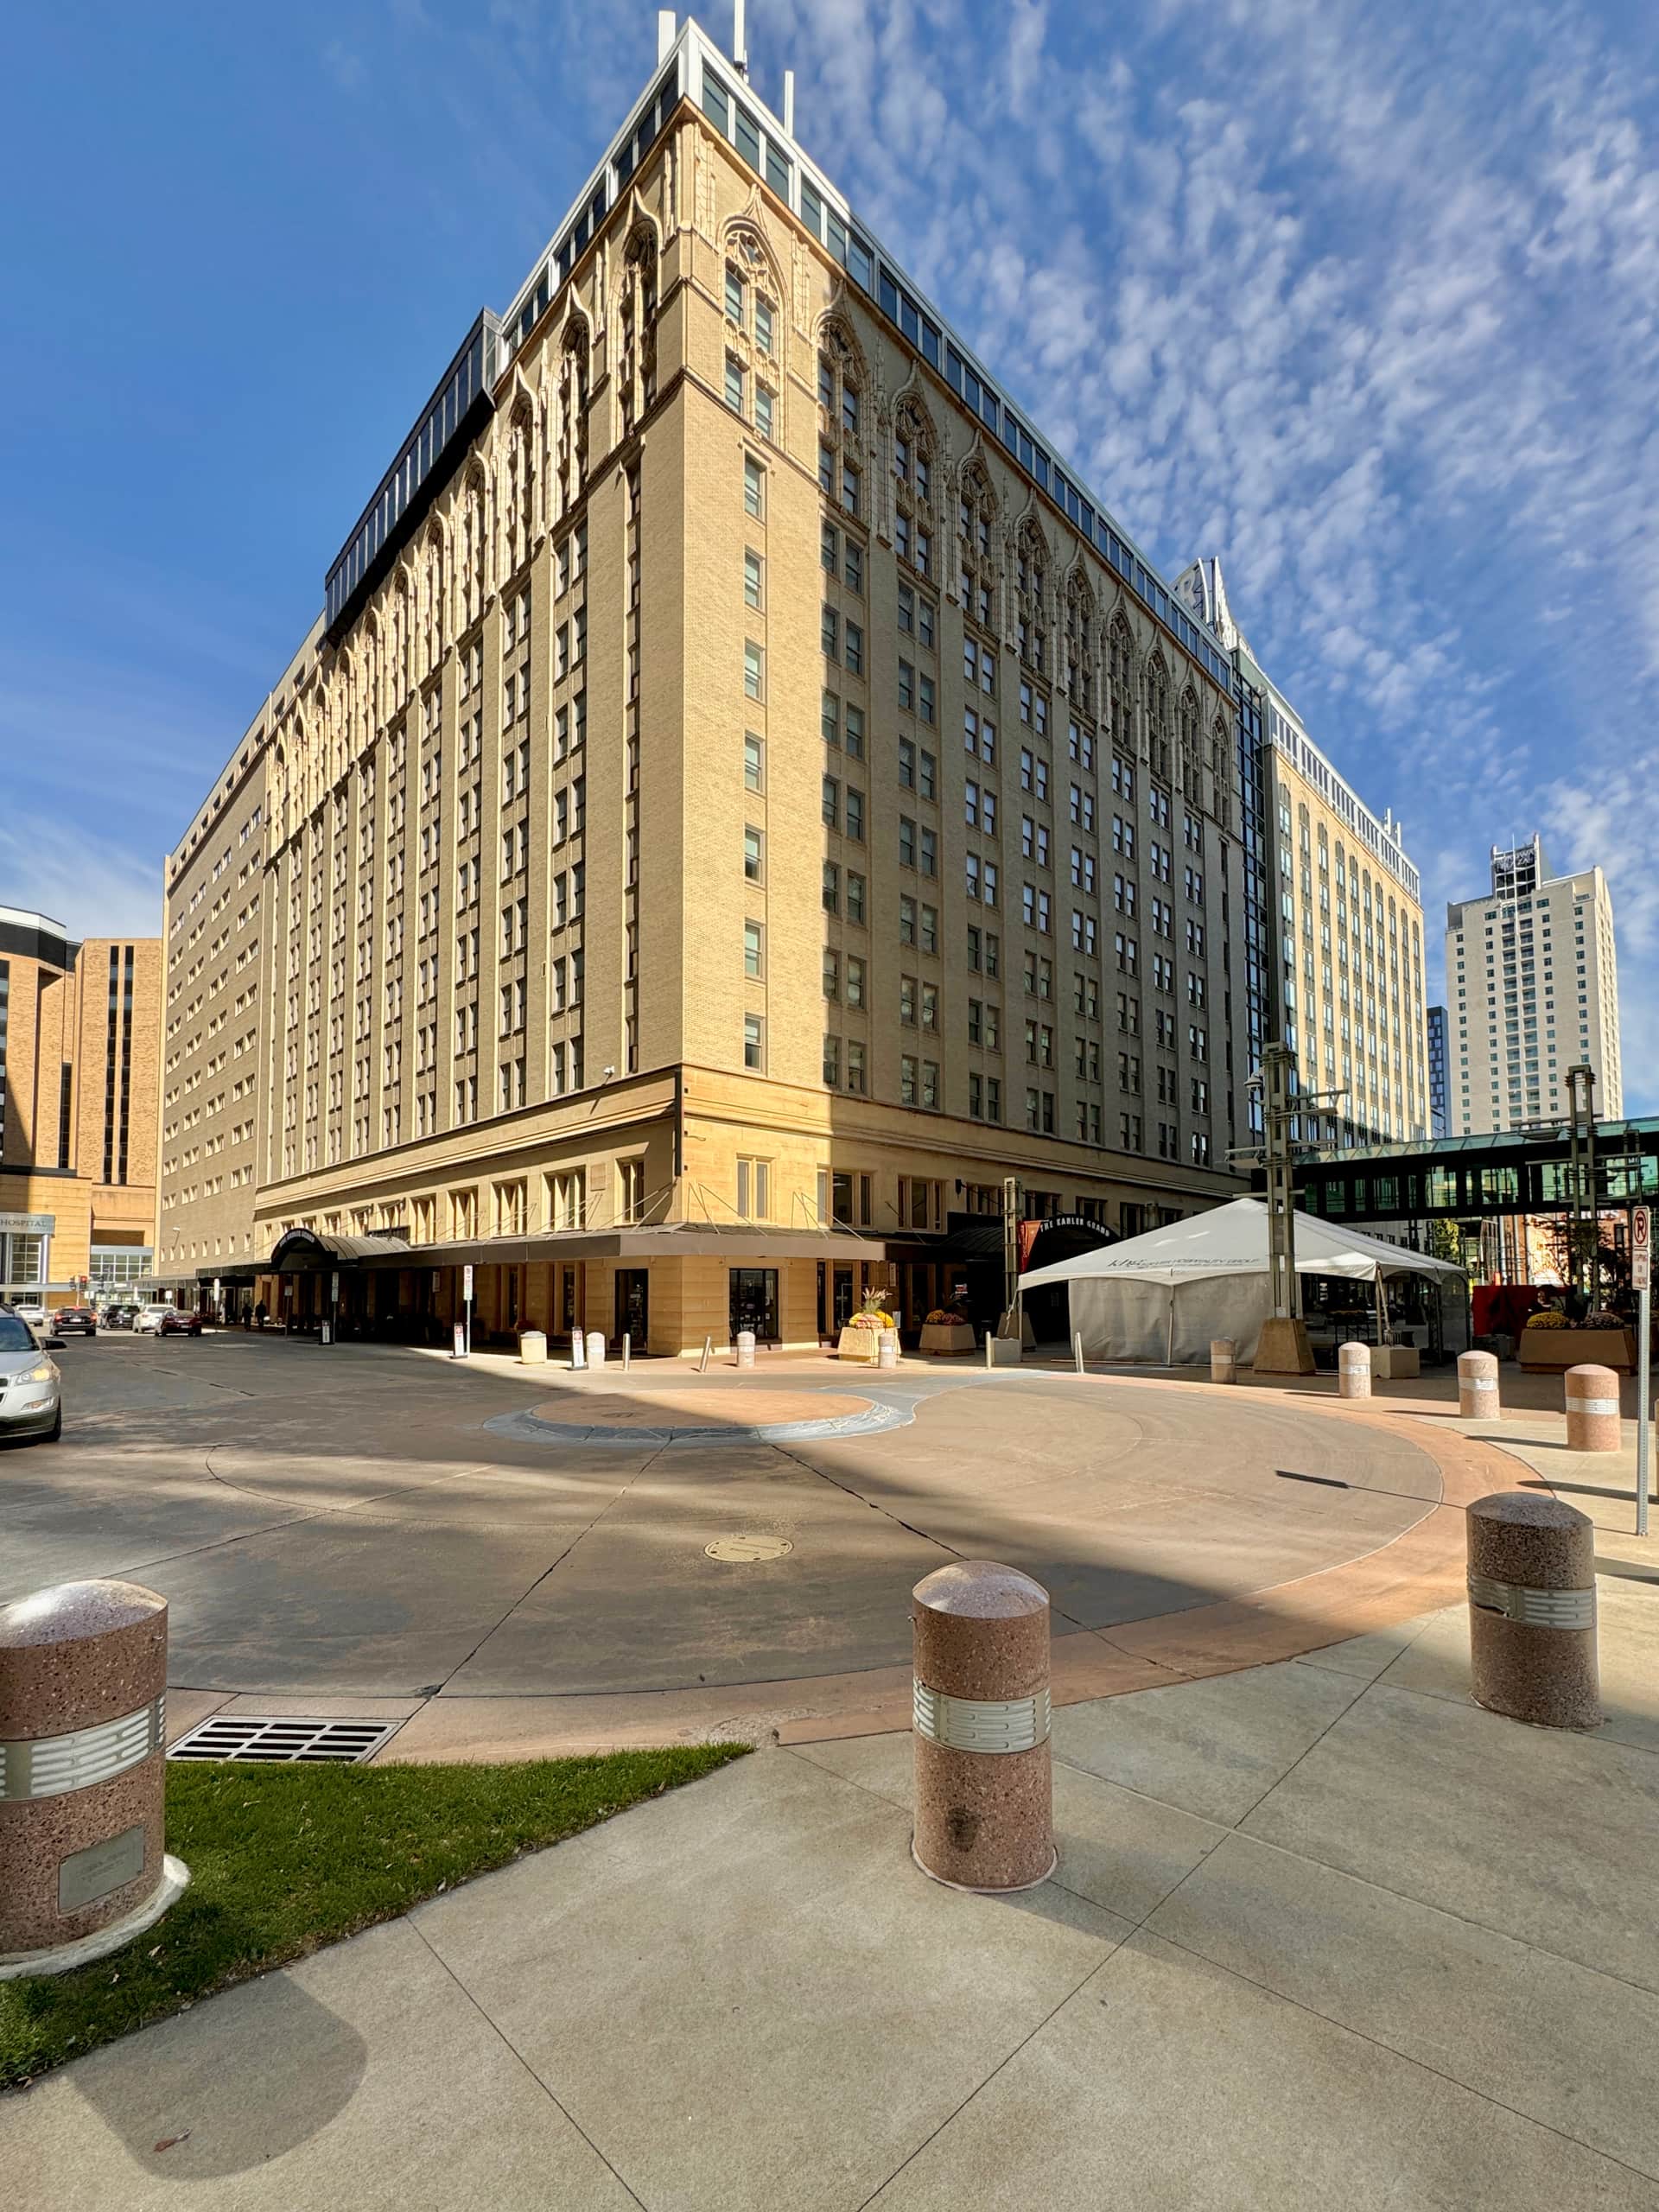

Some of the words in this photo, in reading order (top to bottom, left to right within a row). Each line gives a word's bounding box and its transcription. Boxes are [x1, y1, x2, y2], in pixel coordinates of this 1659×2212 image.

[0, 1218, 47, 1227] HOSPITAL
[1040, 1220, 1053, 1233] THE
[1056, 1217, 1084, 1226] KAHLER
[1086, 1220, 1110, 1237] GRAND
